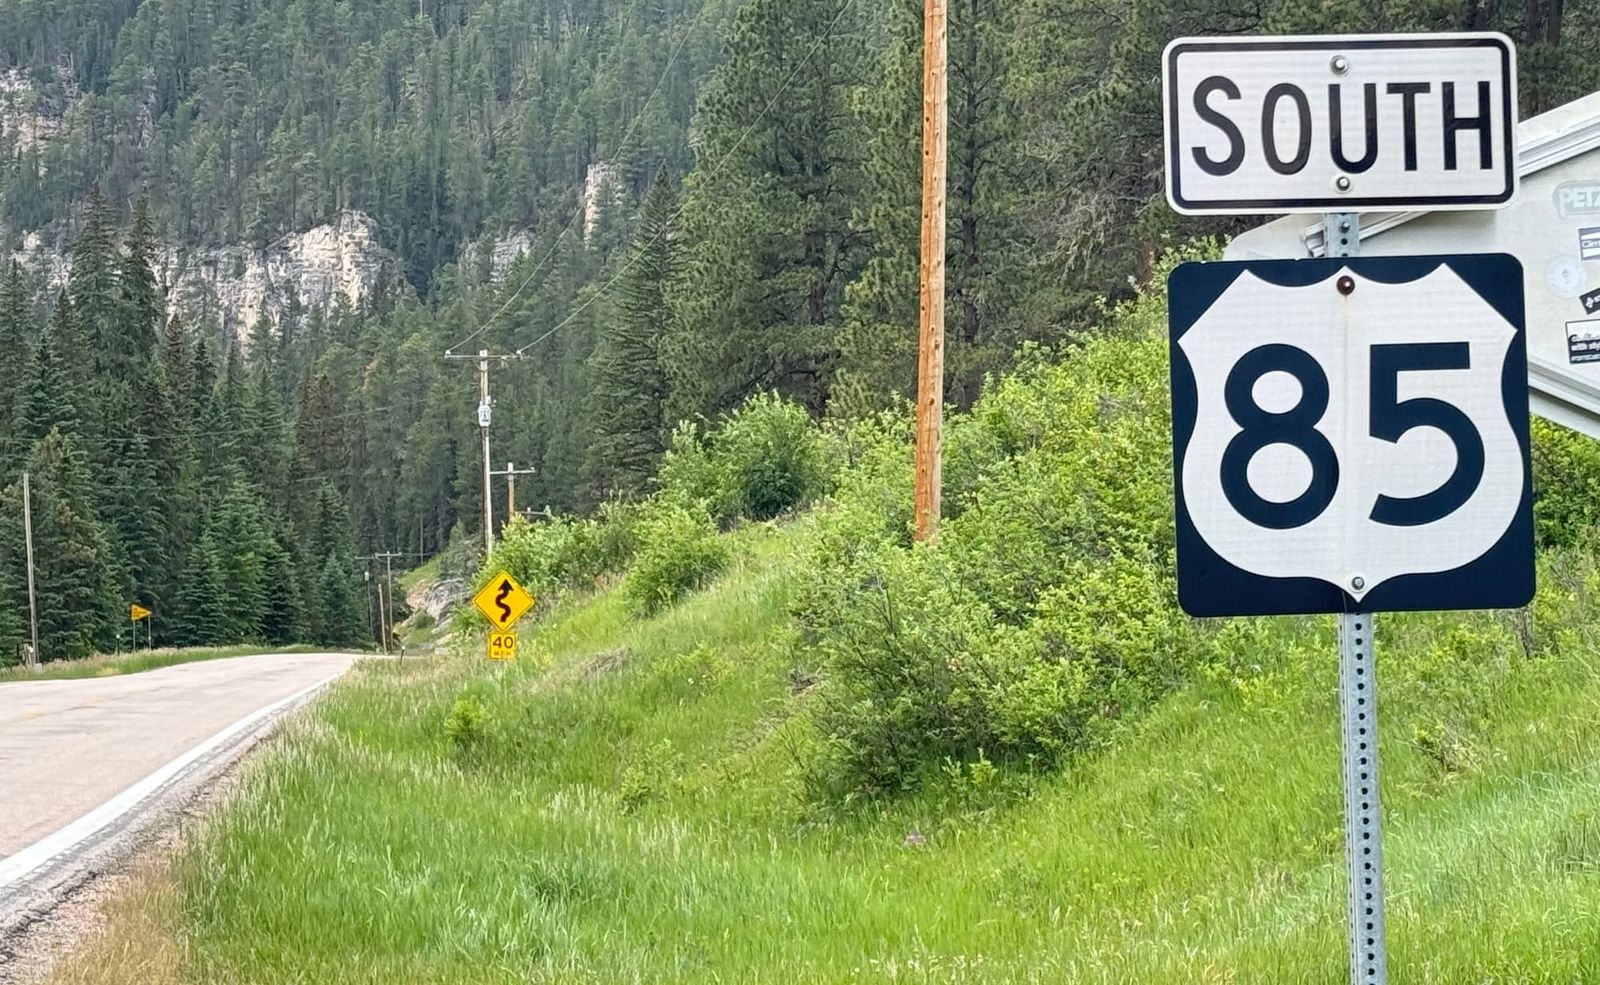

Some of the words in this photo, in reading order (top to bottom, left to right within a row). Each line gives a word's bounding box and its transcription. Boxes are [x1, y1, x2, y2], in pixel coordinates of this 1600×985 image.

[1191, 75, 1494, 177] SOUTH
[1219, 341, 1486, 530] 85
[492, 636, 514, 649] 40
